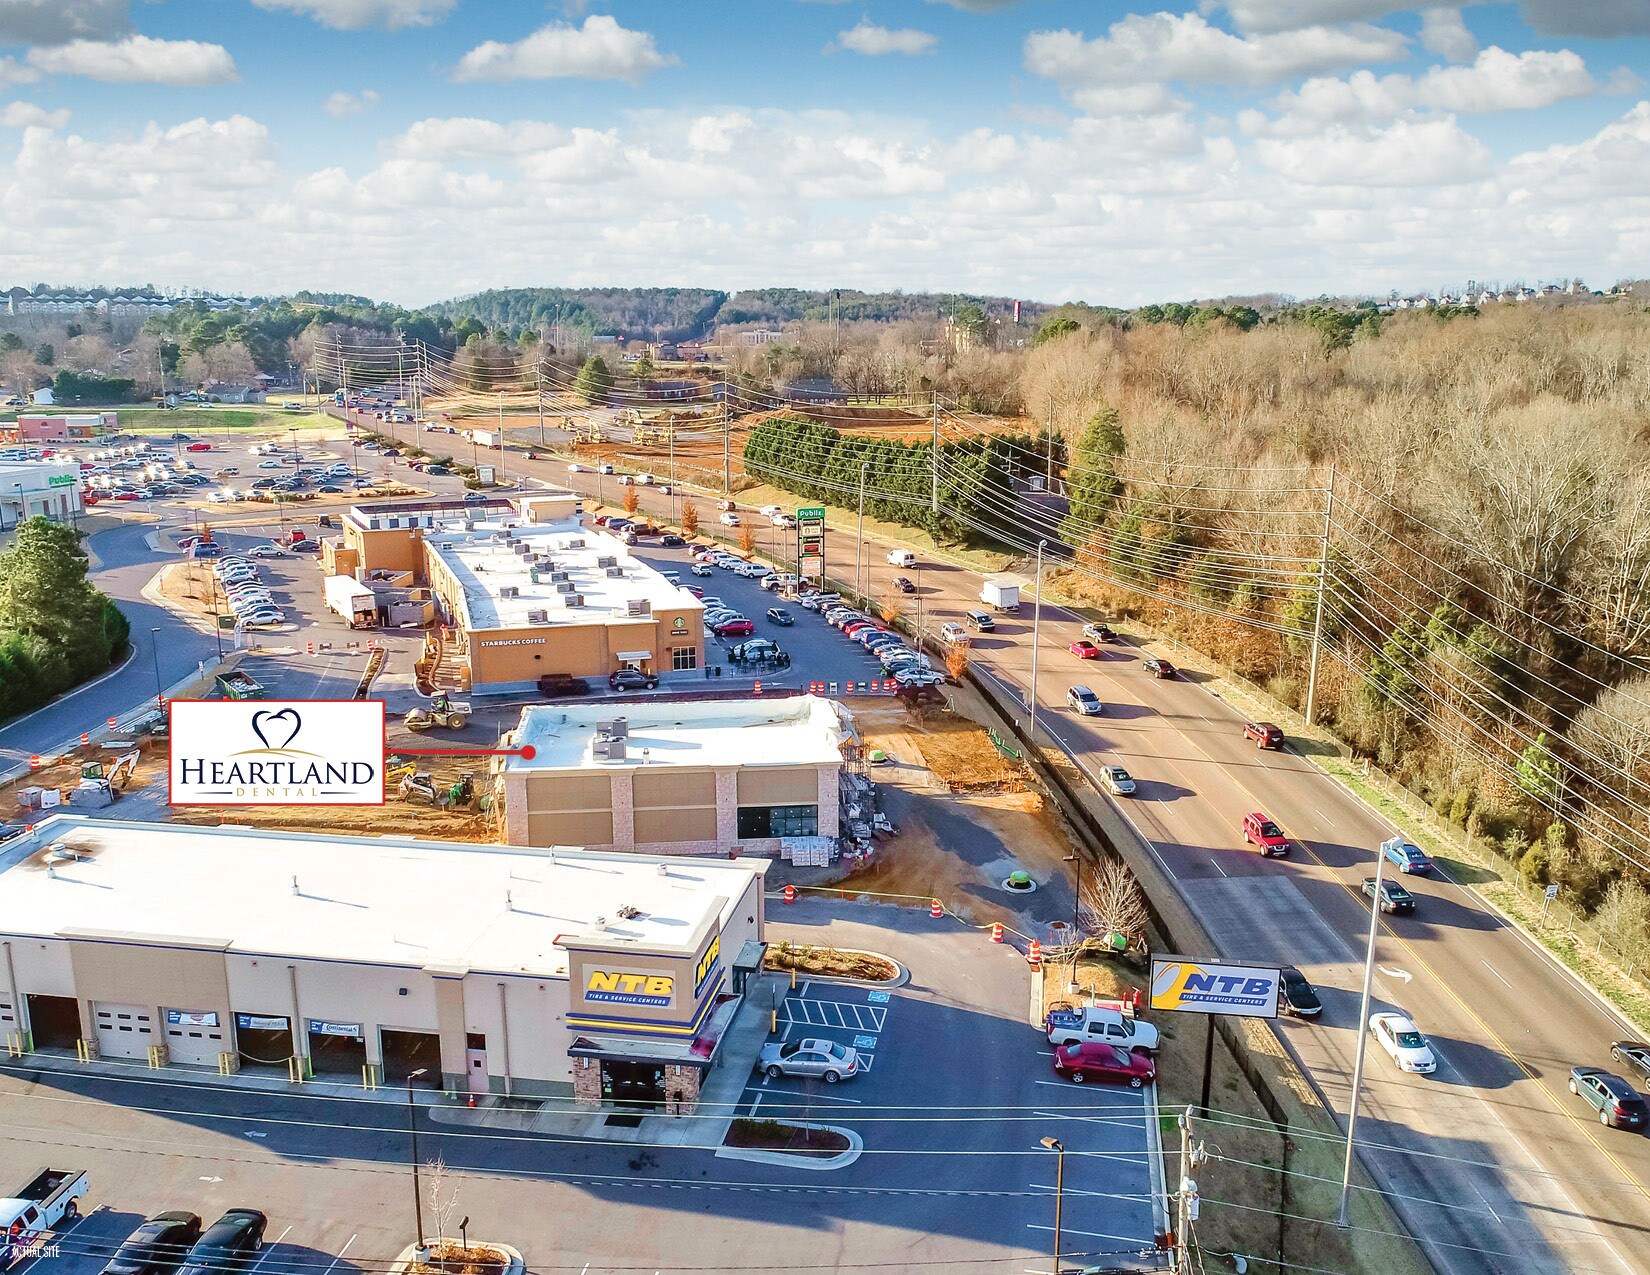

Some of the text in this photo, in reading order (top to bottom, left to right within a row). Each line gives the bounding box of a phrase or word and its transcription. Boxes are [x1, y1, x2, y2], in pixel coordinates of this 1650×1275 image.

[695, 935, 720, 988] NTB
[588, 970, 674, 996] NTB
[1183, 973, 1273, 996] NTB
[1205, 995, 1232, 1003] SERVICE
